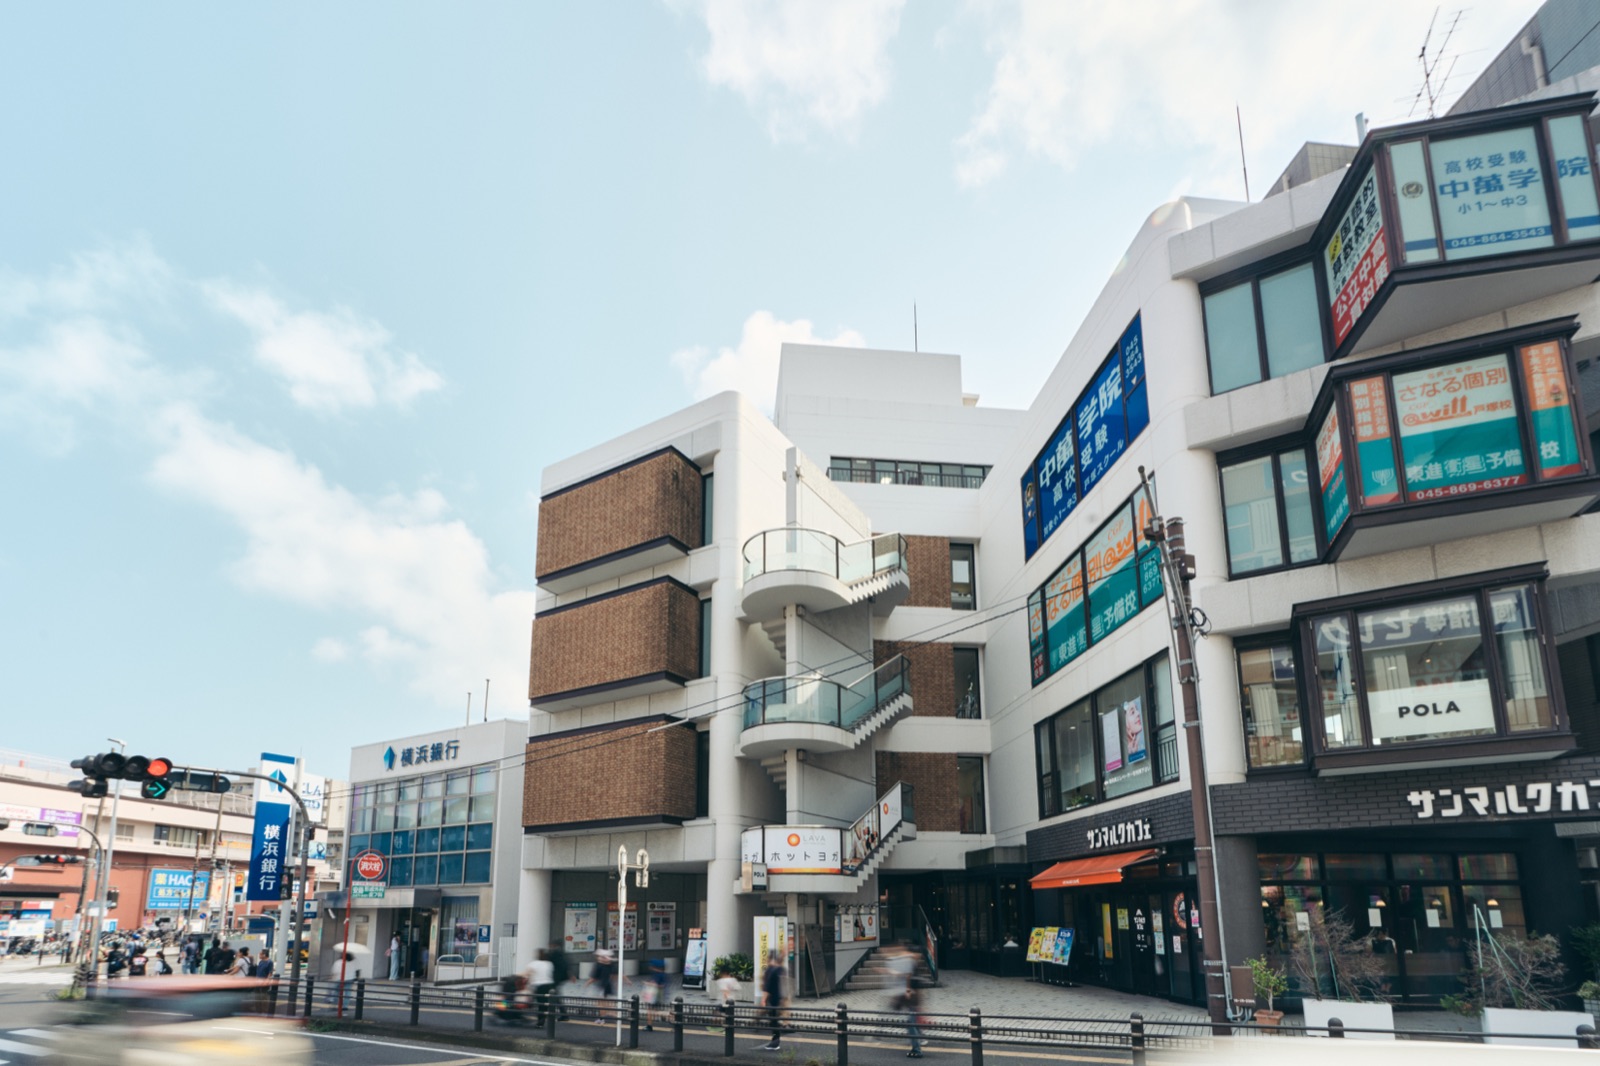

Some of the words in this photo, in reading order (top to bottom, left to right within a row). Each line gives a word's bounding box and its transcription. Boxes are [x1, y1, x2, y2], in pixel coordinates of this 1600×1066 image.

[1444, 150, 1528, 174] 高校受験
[1451, 227, 1546, 248] 045-864-3543
[1398, 366, 1508, 402] さなる個別
[1039, 364, 1123, 488] 中萬学院
[1053, 424, 1109, 507] 高校受験
[1416, 476, 1521, 501] 045-869-6377
[1144, 565, 1158, 582] 869
[1031, 551, 1102, 634] さなる個別
[1398, 700, 1461, 719] POLA
[401, 740, 460, 767] 横浜銀行
[1086, 818, 1152, 849] サンマルクカフェ
[259, 824, 281, 891] 横浜銀行
[361, 861, 381, 872] 消火栓
[770, 850, 839, 862] ホットヨガ
